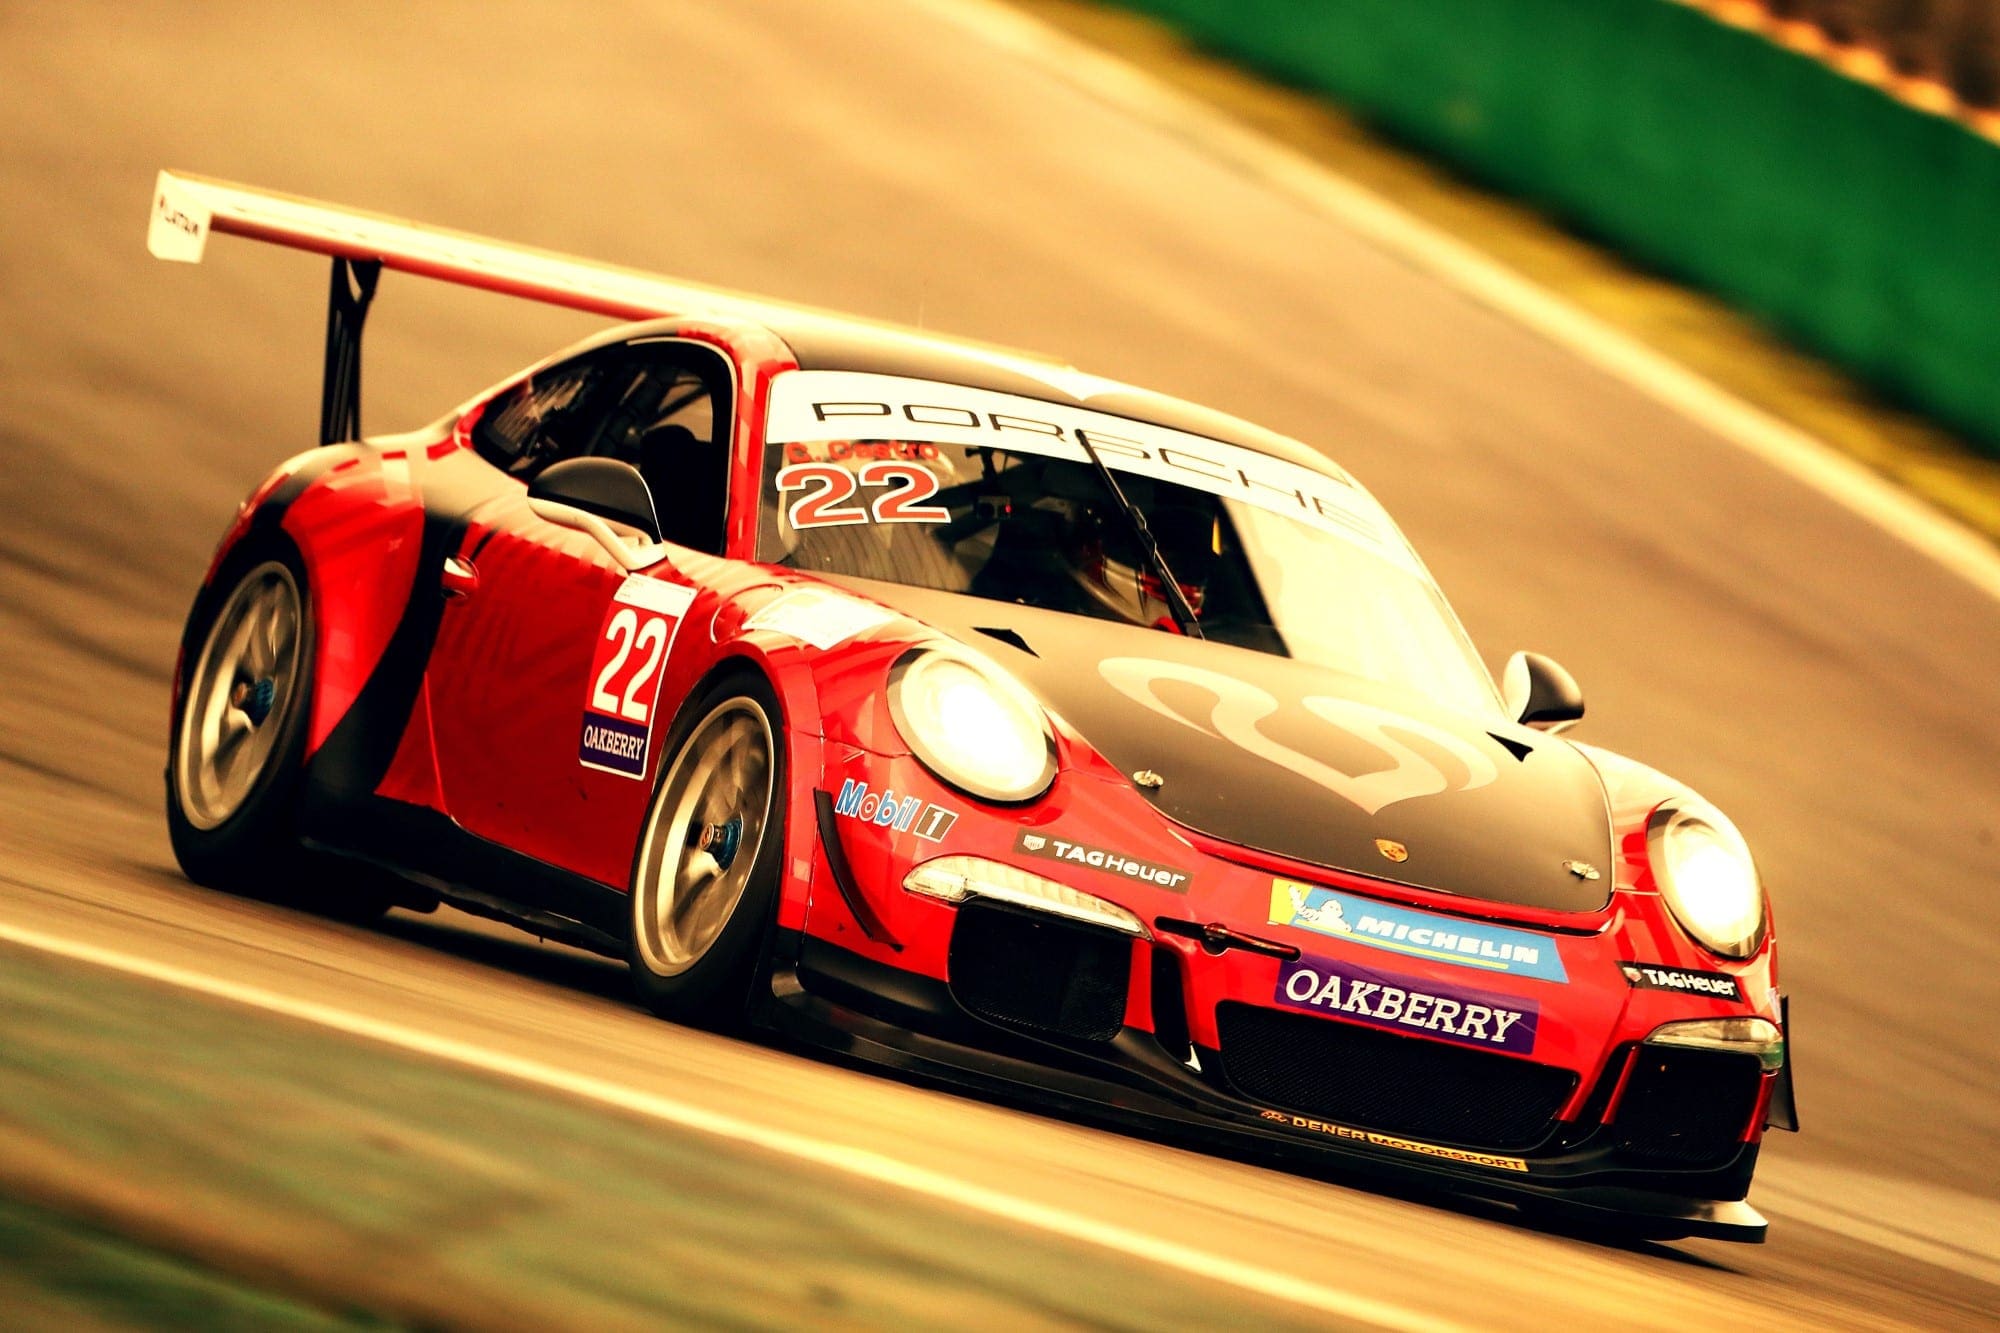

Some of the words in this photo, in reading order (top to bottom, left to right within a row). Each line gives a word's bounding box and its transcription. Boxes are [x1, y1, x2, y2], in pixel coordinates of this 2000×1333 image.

[775, 460, 951, 529] 22
[812, 402, 1383, 544] PORSCHE
[592, 609, 667, 722] 22
[584, 725, 644, 760] OAKBERRY
[835, 778, 922, 832] Mobil
[1356, 916, 1538, 964] MICHELIN
[1286, 970, 1521, 1042] OAKBERRY
[1292, 1117, 1366, 1141] DENER
[1372, 1135, 1523, 1170] MOTORSPORT
